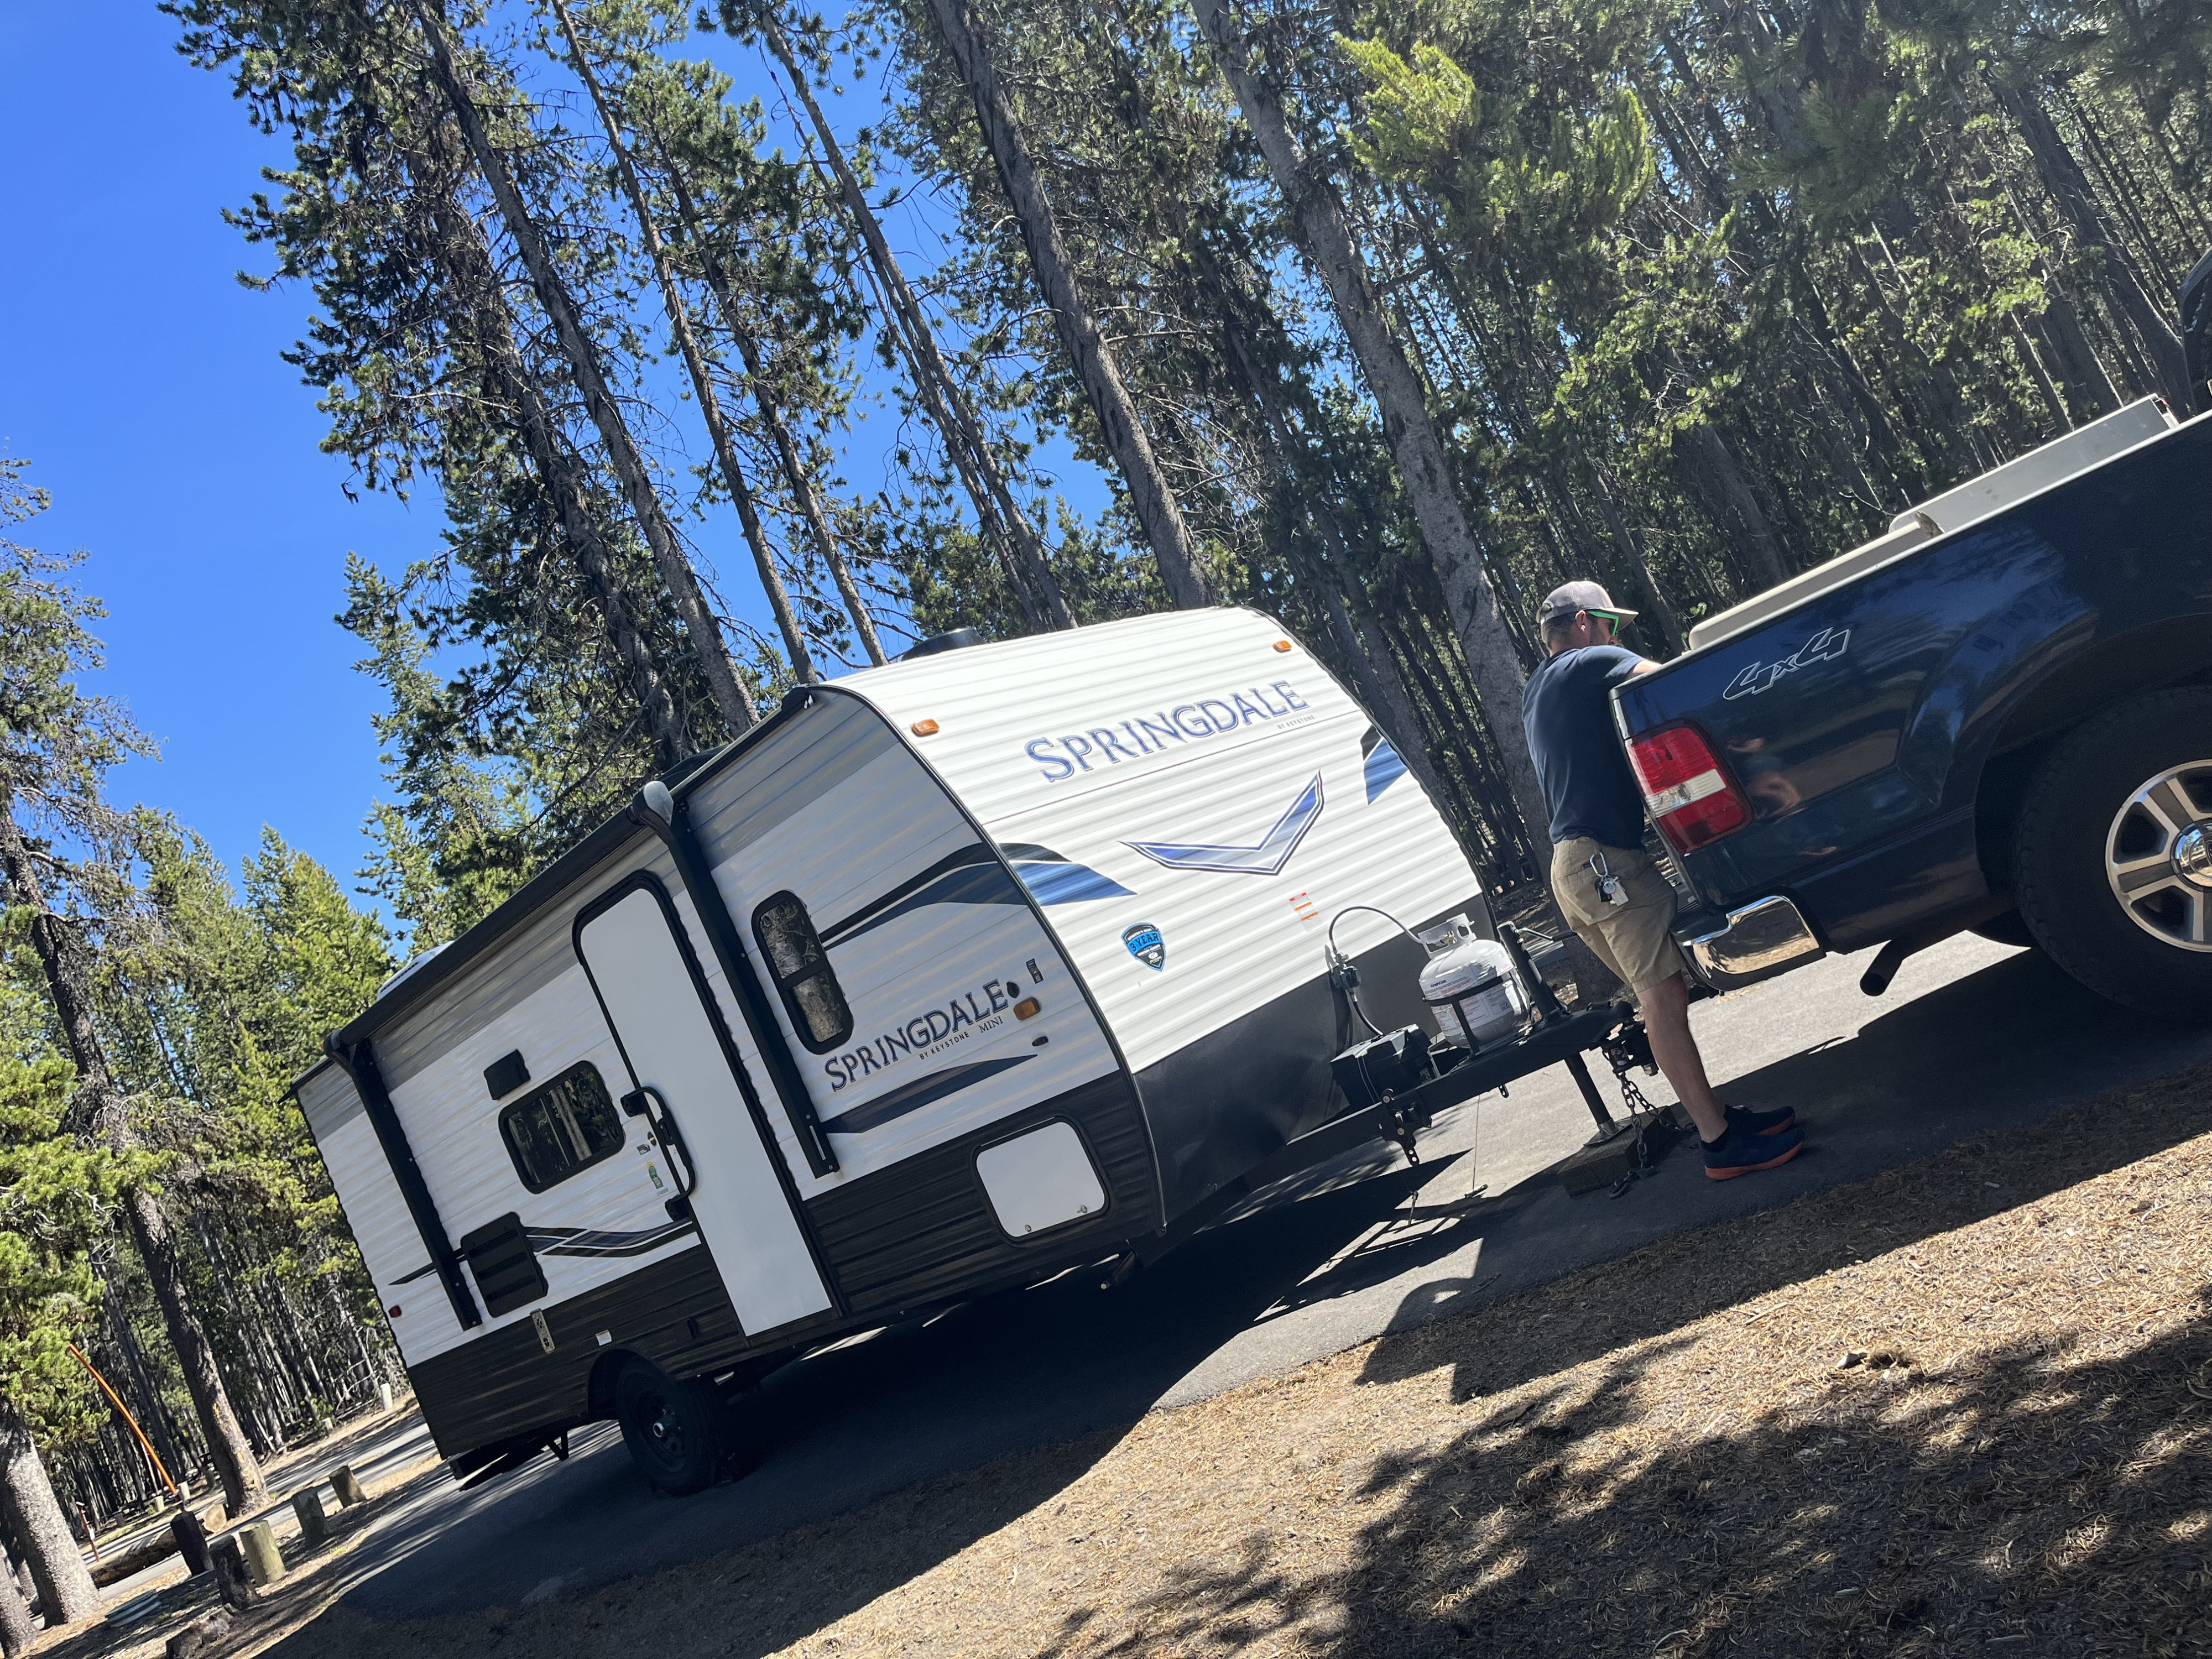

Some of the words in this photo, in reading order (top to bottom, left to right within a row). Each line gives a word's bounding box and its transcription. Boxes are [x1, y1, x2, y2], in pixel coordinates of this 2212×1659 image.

[1723, 627, 1851, 701] 4x4
[1024, 680, 1310, 783] SPRINGDALE
[1286, 715, 1316, 727] KEYSTONE
[1130, 942, 1136, 952] 3
[1135, 932, 1159, 946] YEAR
[824, 978, 1009, 1093] SPRINGDALE
[930, 1031, 969, 1055] KEYSTONE
[978, 1015, 1004, 1033] MINI
